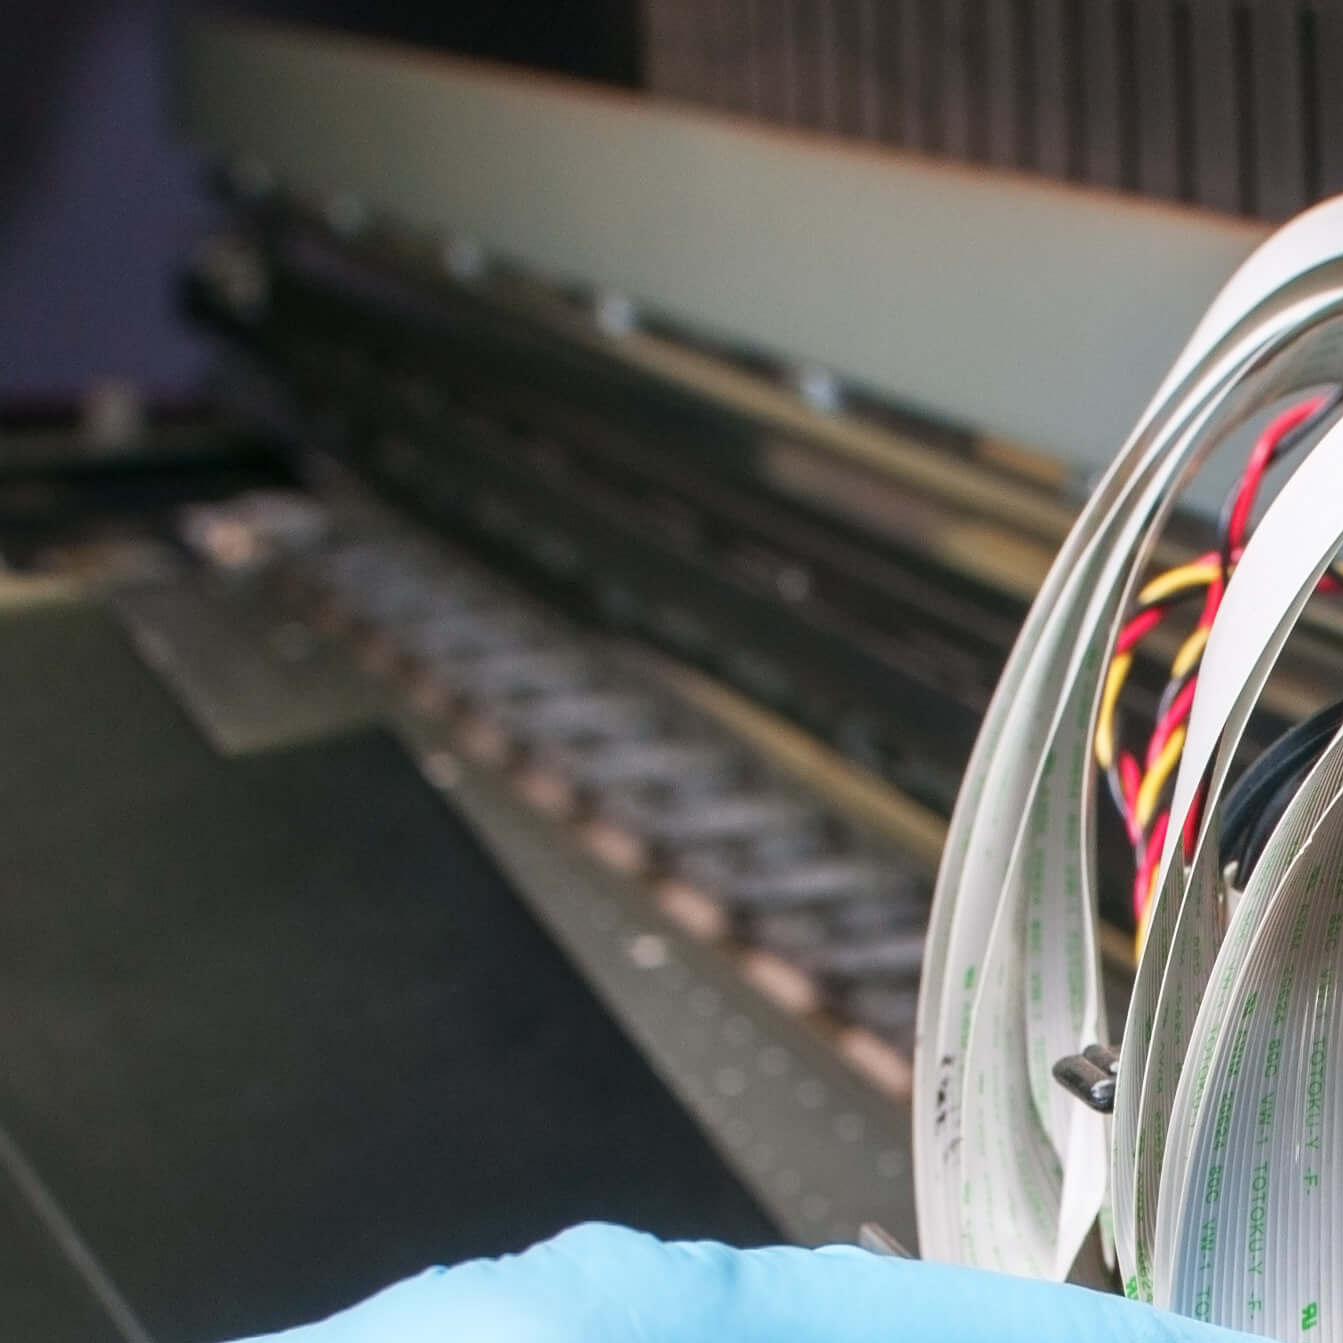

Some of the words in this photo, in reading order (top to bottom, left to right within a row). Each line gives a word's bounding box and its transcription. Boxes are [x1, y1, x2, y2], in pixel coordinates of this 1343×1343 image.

[1304, 1037, 1327, 1149] TOTOKU-Y
[1303, 1167, 1319, 1195] -F-
[1248, 1160, 1269, 1275] TOTOKU-Y
[1199, 1218, 1217, 1272] VW-1
[1248, 1293, 1262, 1320] -F-
